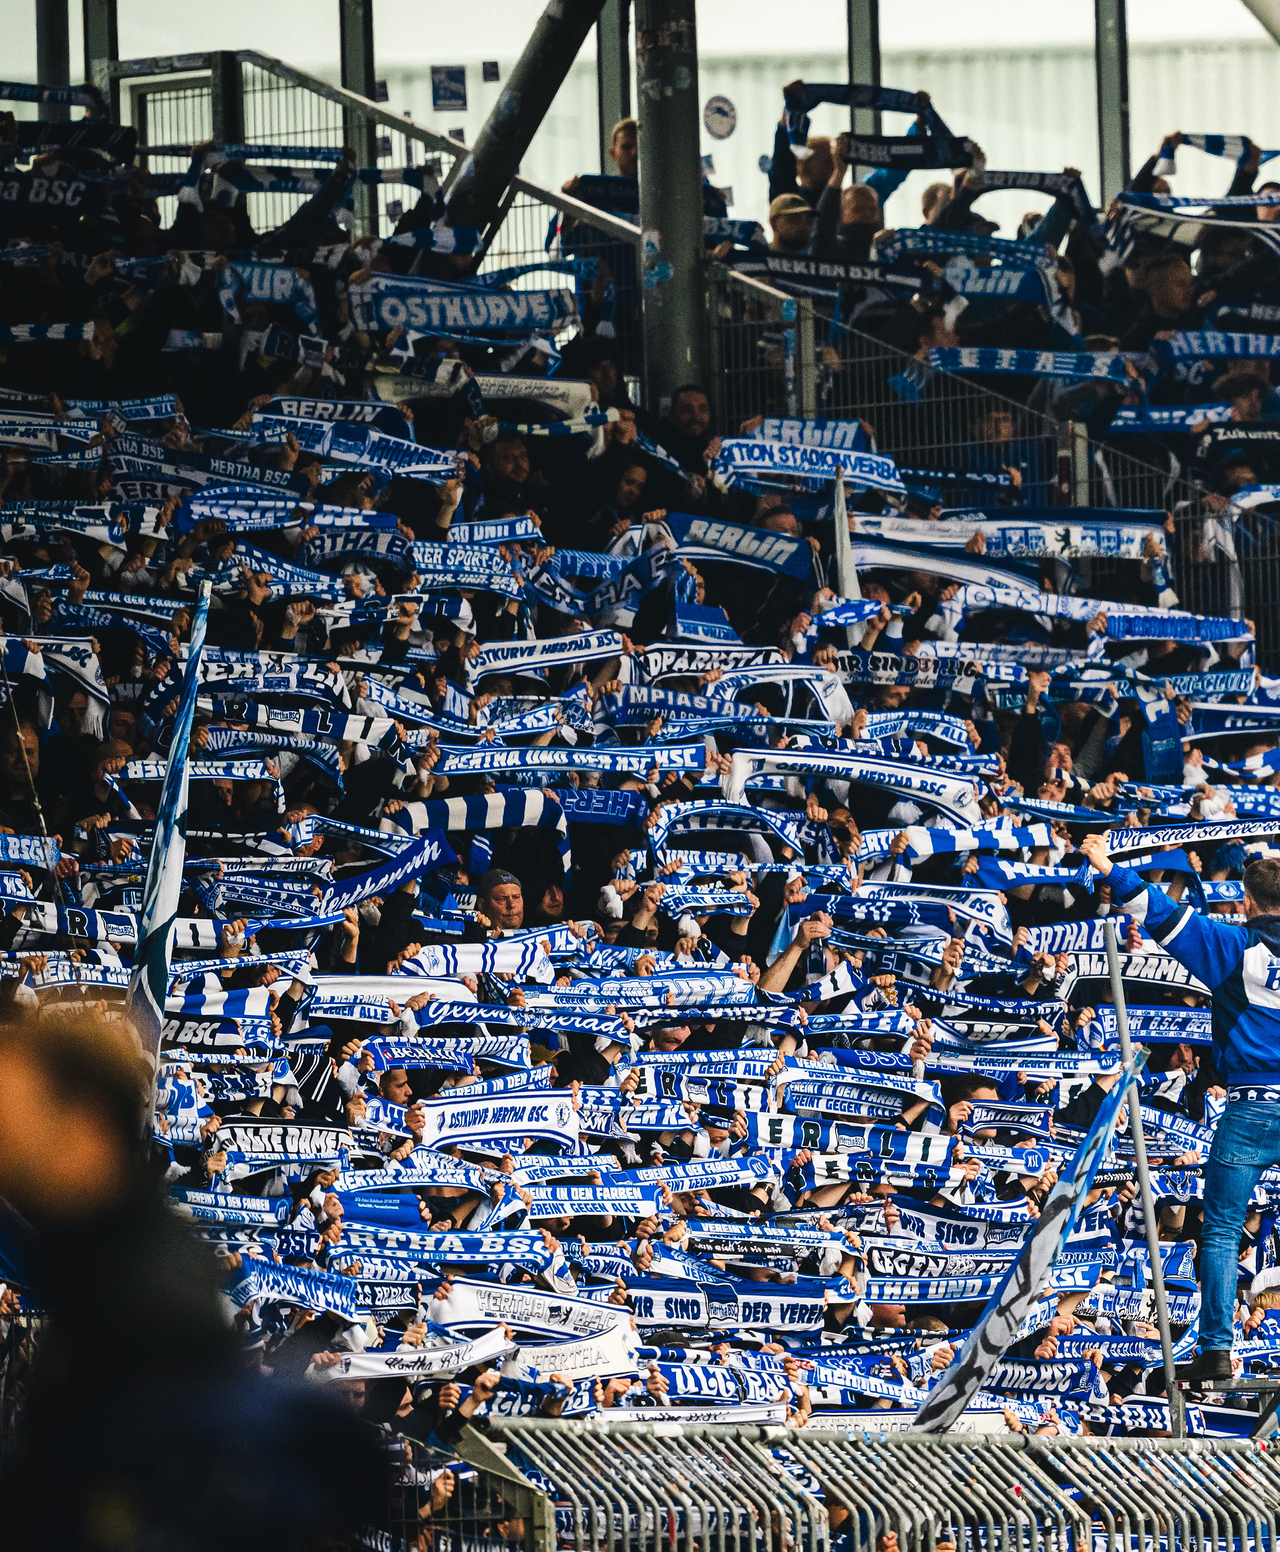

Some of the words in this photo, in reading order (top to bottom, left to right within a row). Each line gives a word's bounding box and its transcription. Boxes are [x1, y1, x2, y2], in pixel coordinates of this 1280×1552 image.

[29, 180, 86, 207] BSC
[379, 293, 549, 327] OSTKURVE
[281, 400, 382, 423] BERLIN
[141, 442, 165, 460] BSC
[210, 458, 261, 480] HERTHA
[264, 469, 292, 486] BSC
[683, 520, 799, 565] BERLIN
[67, 644, 91, 669] BSC
[540, 635, 591, 657] HERTHA
[866, 719, 905, 738] VEREINT
[444, 752, 520, 771] HERTHA
[526, 751, 569, 768] UND
[572, 752, 612, 768] DER
[655, 747, 698, 768] KSC
[858, 769, 913, 791] HERTHA
[920, 779, 947, 797] BSC
[1106, 828, 1146, 851] Wir
[1151, 823, 1195, 844] sind
[1199, 820, 1224, 842] so
[1230, 819, 1265, 836] wie
[7, 836, 46, 860] BSC
[240, 893, 266, 906] WALK
[271, 898, 306, 914] ALONE
[968, 897, 995, 916] BSC
[1126, 955, 1194, 980] DAME
[358, 1006, 390, 1021] ALLE
[180, 1020, 217, 1046] BSC
[641, 1052, 688, 1063] VEREINT
[694, 1052, 707, 1062] IN
[711, 1051, 733, 1061] DEN
[974, 1056, 1011, 1069] VEREINT
[1015, 1059, 1048, 1070] GEGEN
[1050, 1059, 1081, 1071] ALLE
[449, 1108, 485, 1130] OSTKURVE
[488, 1105, 527, 1124] HERTHA
[528, 1104, 548, 1122] BSC
[1020, 1110, 1046, 1126] BSC
[237, 1125, 283, 1153] ALTE
[335, 1169, 398, 1191] HERTHA
[403, 1169, 431, 1185] UND
[438, 1169, 468, 1186] DER
[635, 1166, 669, 1182] VEREINT
[672, 1165, 682, 1178] IN
[683, 1163, 703, 1177] DEN
[705, 1159, 740, 1175] FARBEN
[572, 1187, 593, 1200] DEN
[596, 1186, 641, 1200] FARBEN
[748, 1225, 759, 1235] IN
[765, 1227, 791, 1236] DEN
[935, 1221, 978, 1244] SIND
[478, 1292, 545, 1318] HERTHA
[1031, 1362, 1079, 1390] BSC
